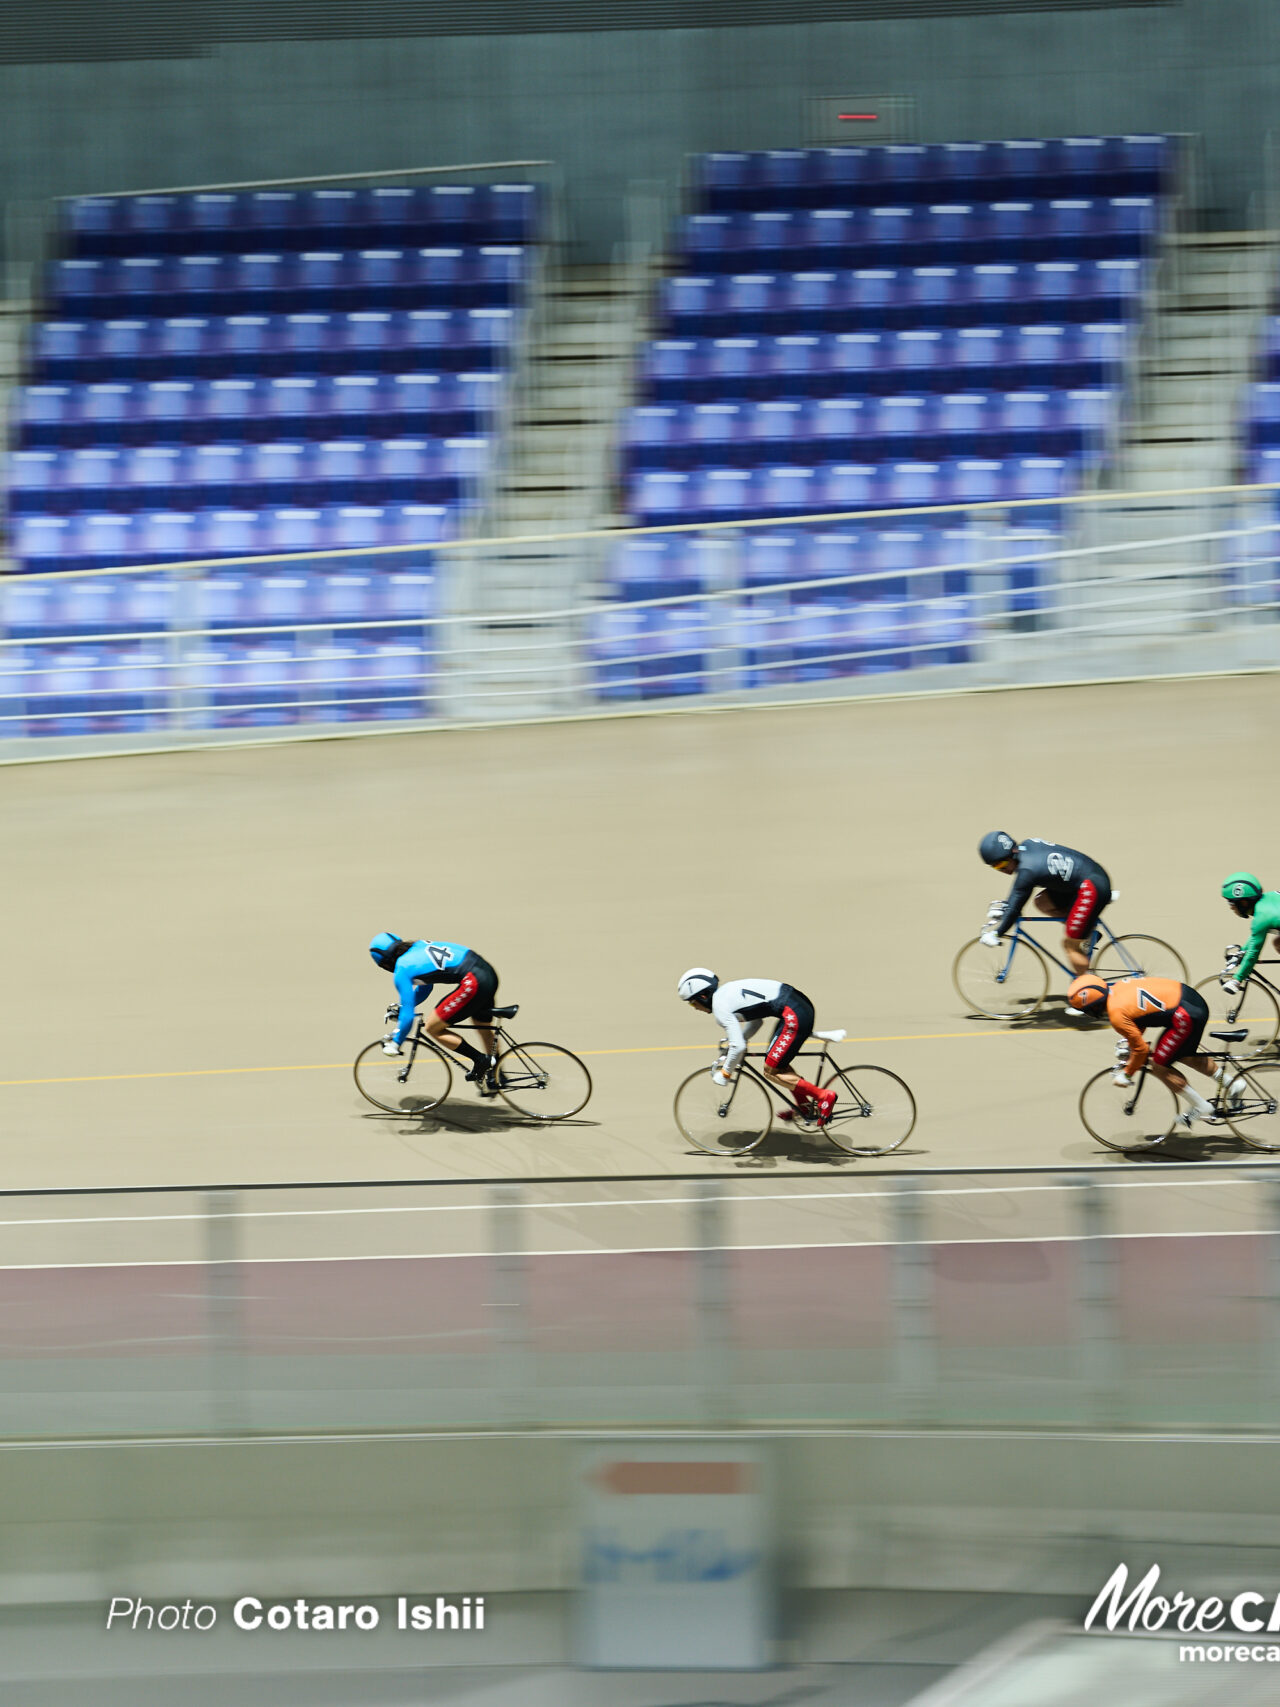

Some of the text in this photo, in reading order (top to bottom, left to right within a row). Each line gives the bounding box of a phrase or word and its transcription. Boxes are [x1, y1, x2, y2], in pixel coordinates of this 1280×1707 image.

[1232, 882, 1245, 898] 6
[425, 945, 455, 971] 4
[1136, 987, 1167, 1013] 7
